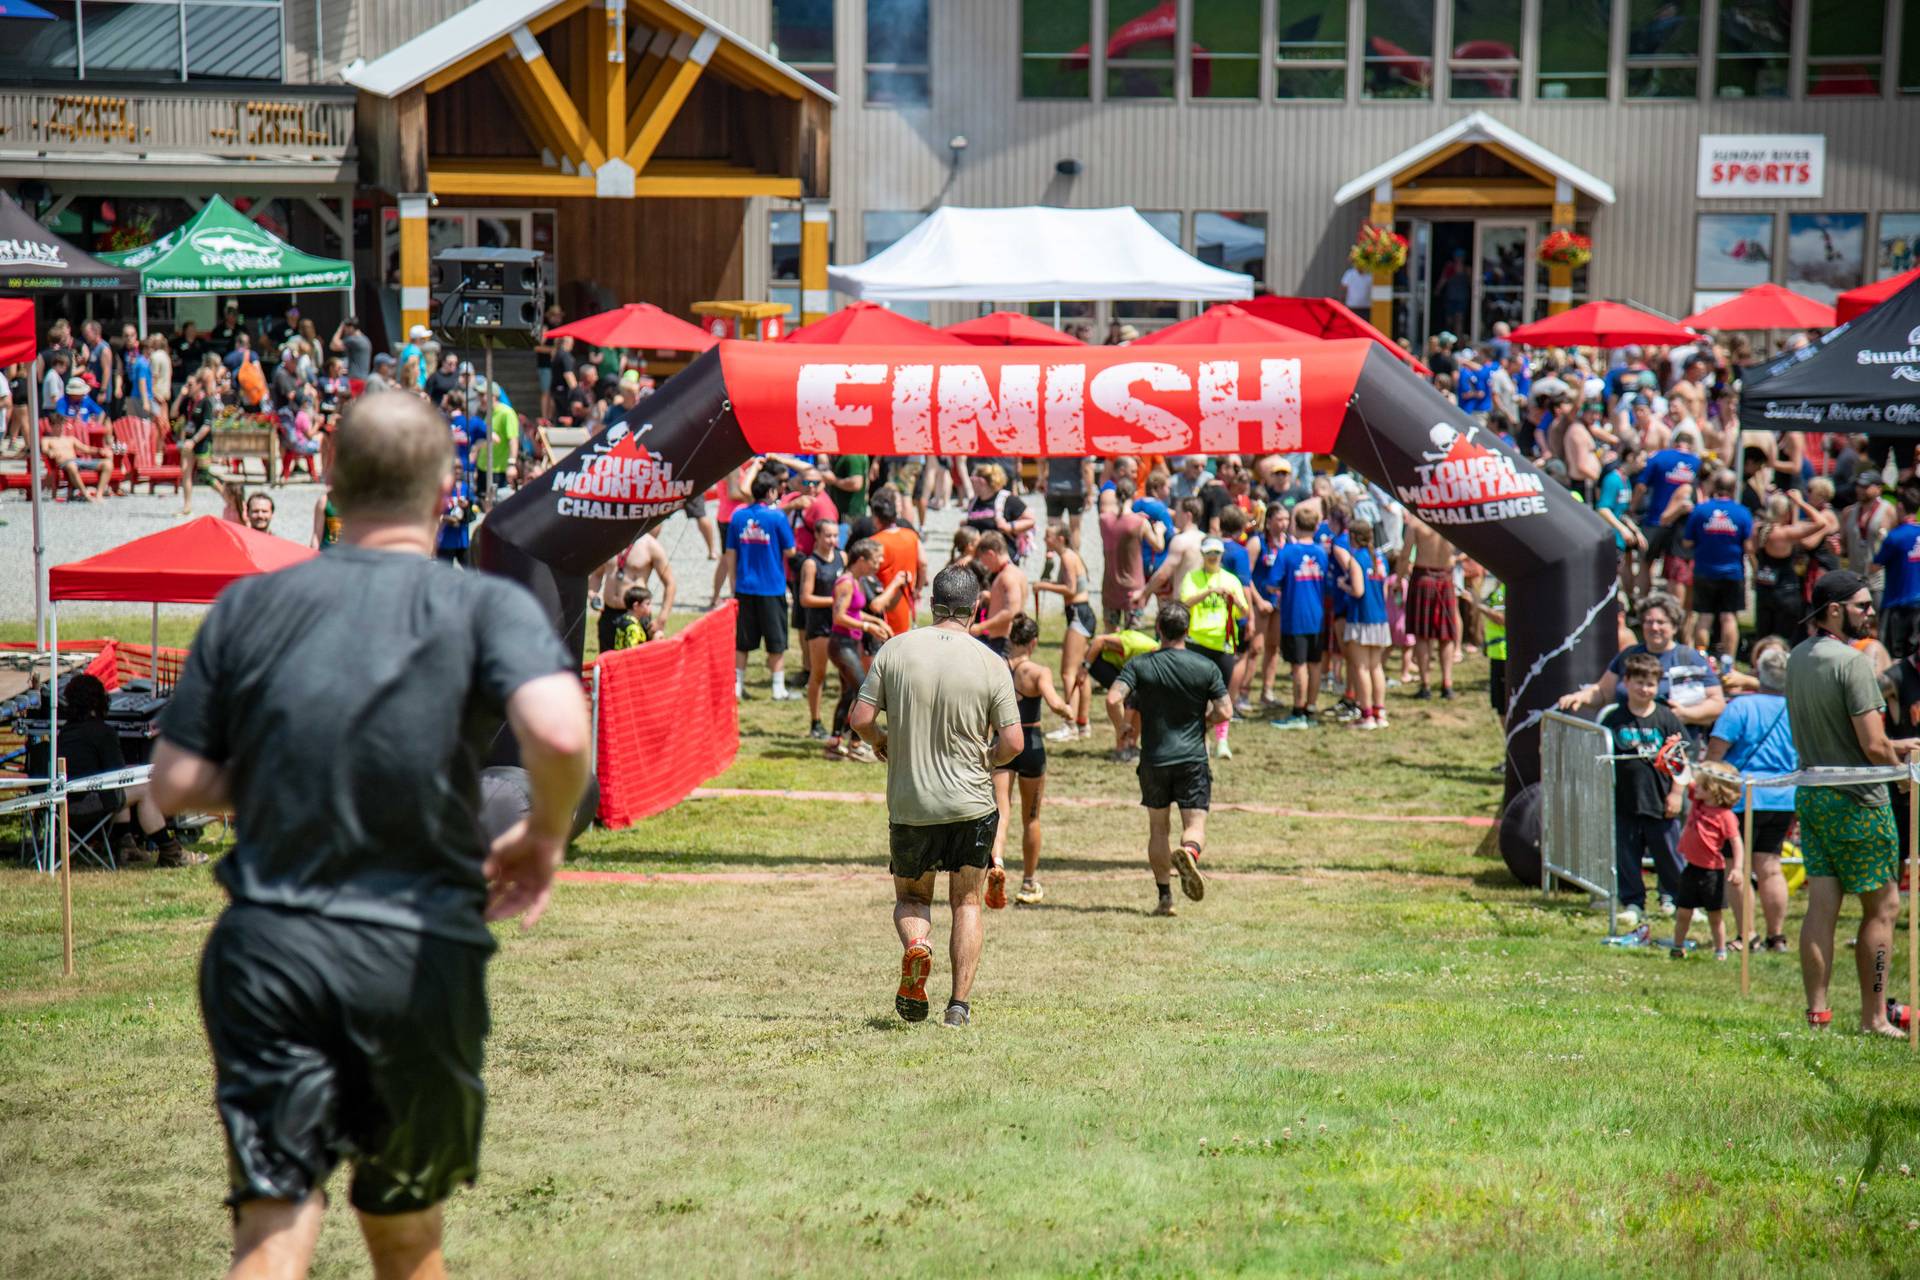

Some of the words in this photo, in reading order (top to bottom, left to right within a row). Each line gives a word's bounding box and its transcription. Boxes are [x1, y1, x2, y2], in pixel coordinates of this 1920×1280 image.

[1711, 163, 1810, 184] SPORTS
[796, 358, 1302, 454] FINISH
[1764, 402, 1825, 424] Sunday
[1827, 404, 1881, 422] River's
[581, 454, 672, 481] TOUGH
[1414, 455, 1517, 487] TOUGH
[552, 471, 695, 500] MOUNTAIN
[1397, 472, 1545, 506] MOUNTAIN
[557, 497, 687, 521] CHALLENGE
[1416, 496, 1549, 525] CHALLENGE
